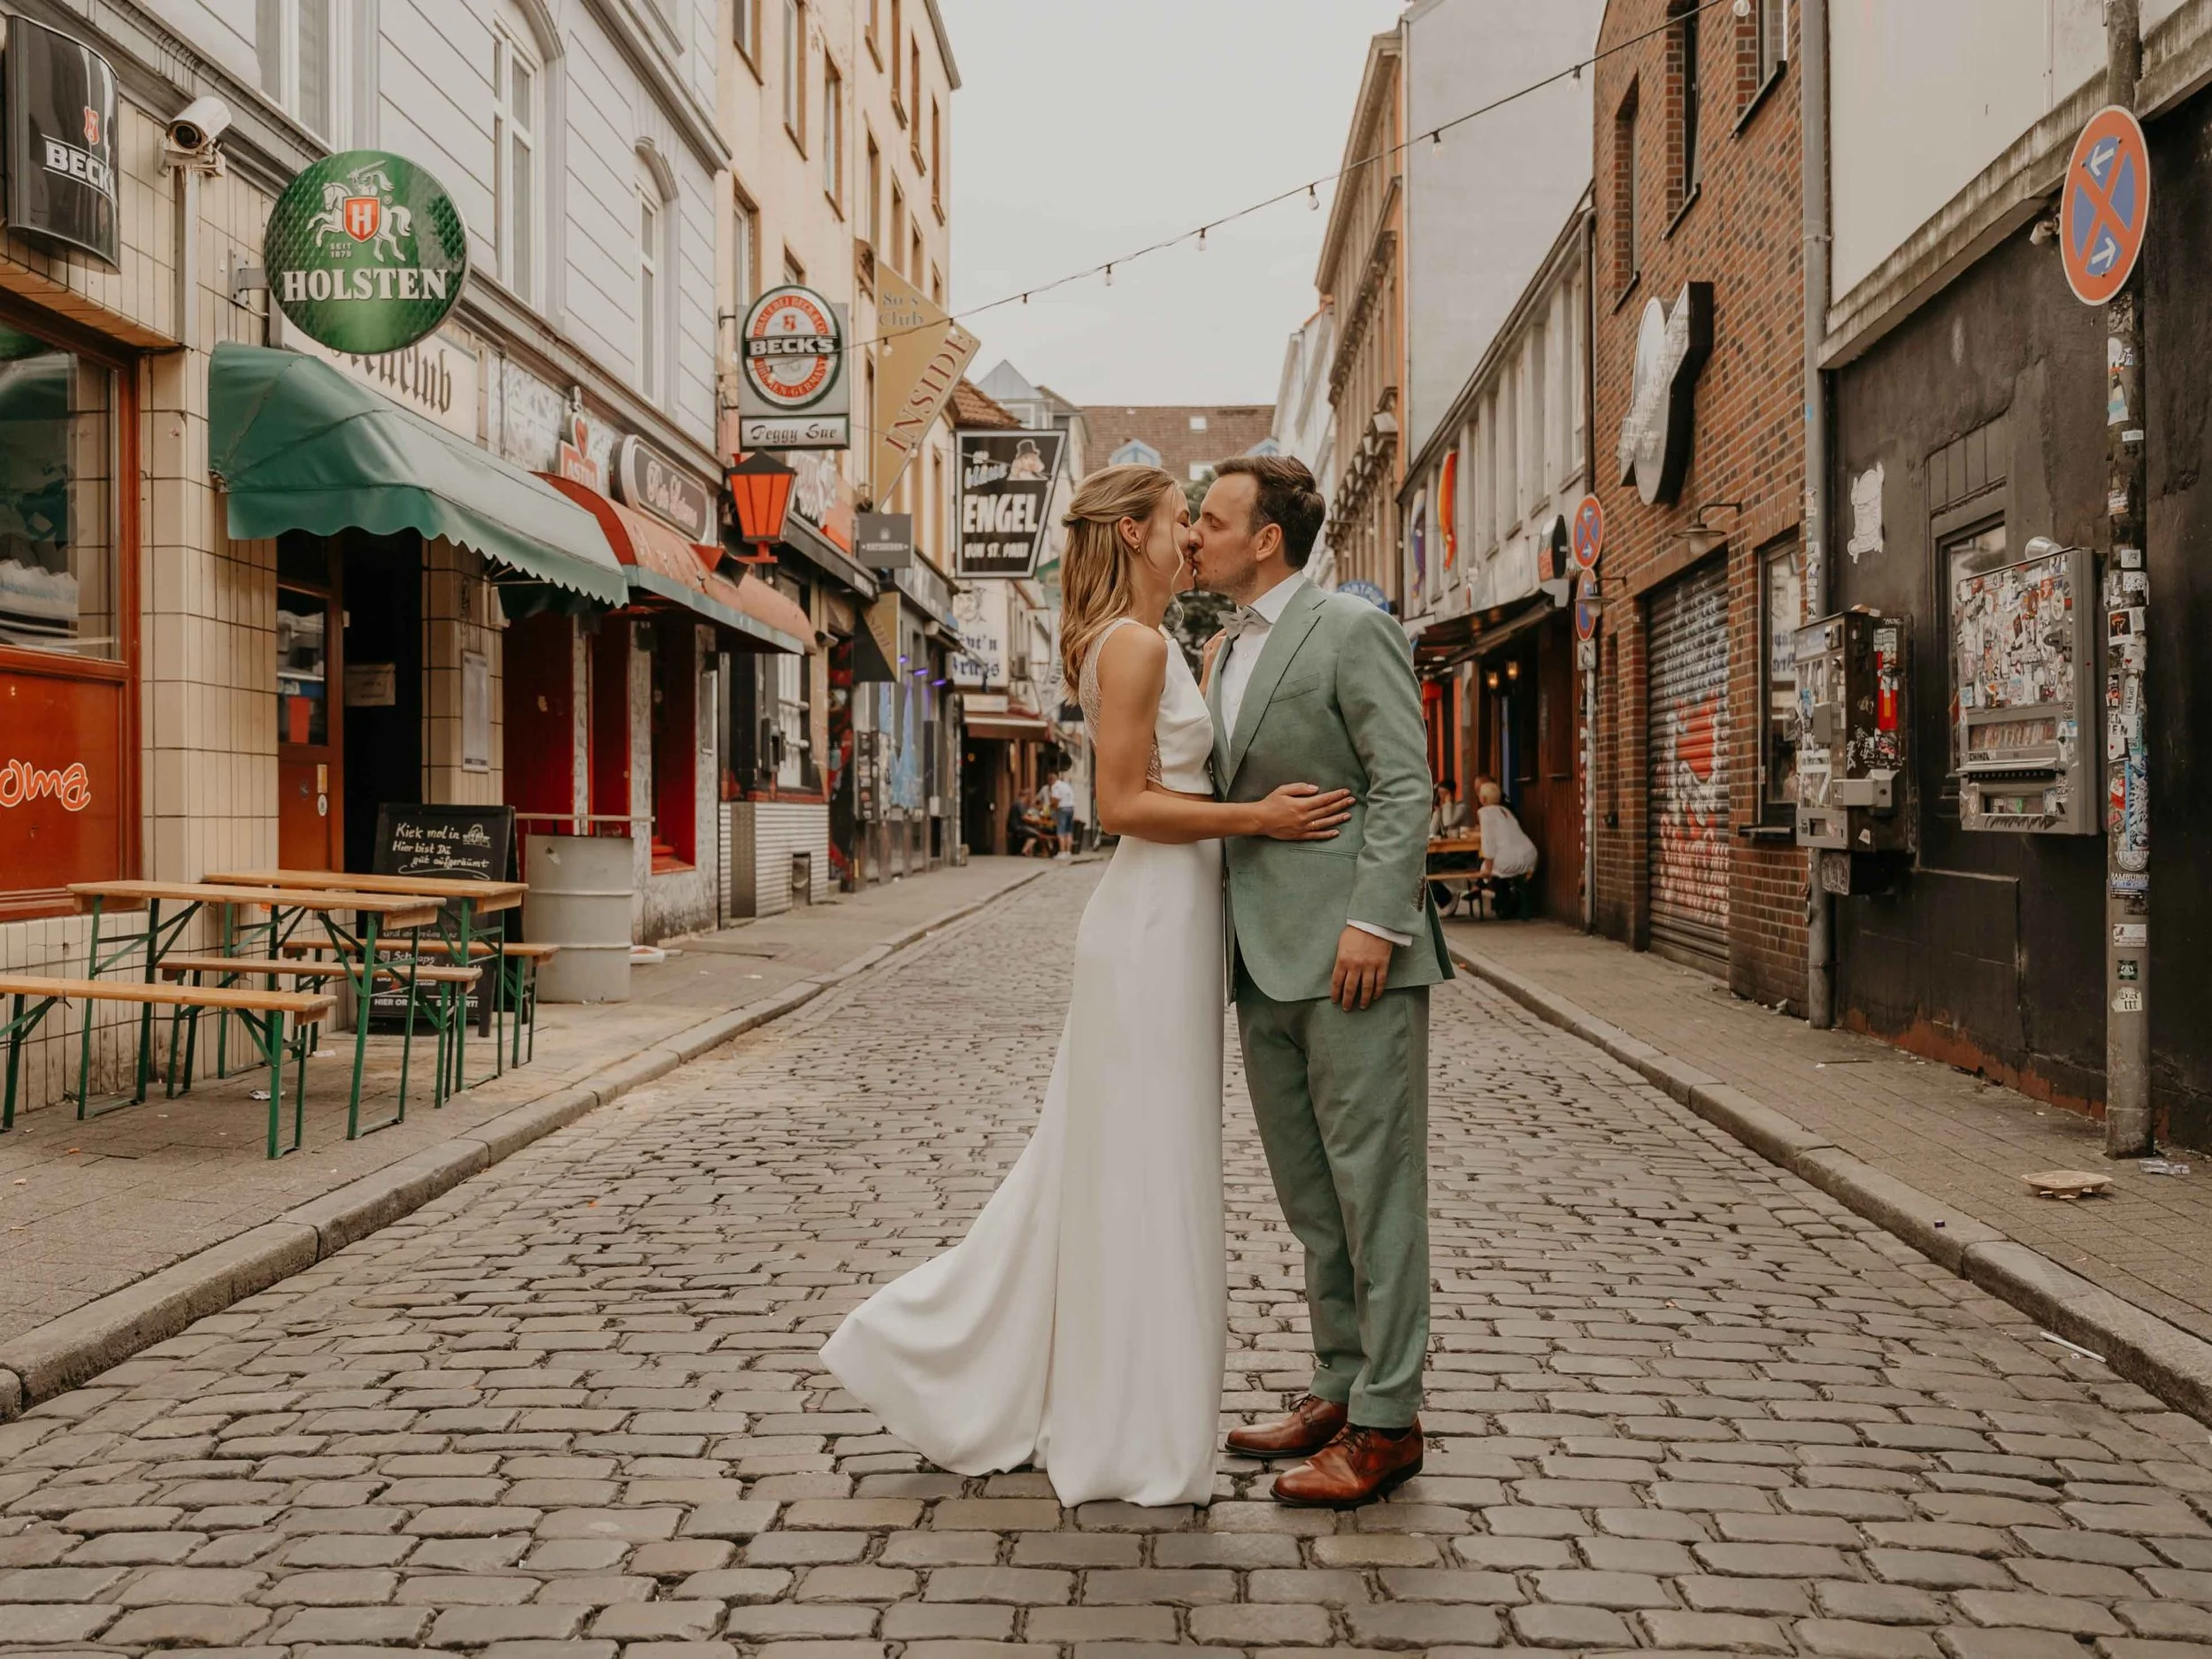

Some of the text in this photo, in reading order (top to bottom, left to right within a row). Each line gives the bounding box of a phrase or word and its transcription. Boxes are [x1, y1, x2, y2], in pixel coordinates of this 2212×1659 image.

[282, 268, 449, 302] HOLSTEN
[878, 311, 924, 326] Club
[749, 336, 834, 356] BECK'S
[885, 335, 973, 454] INSIDE
[750, 423, 837, 443] Peggy Sue
[964, 494, 1038, 533] ENGEL
[396, 822, 424, 839] Kiek
[449, 826, 460, 840] in
[392, 841, 414, 852] Hier
[415, 841, 434, 854] bist
[393, 950, 436, 965] Schaps
